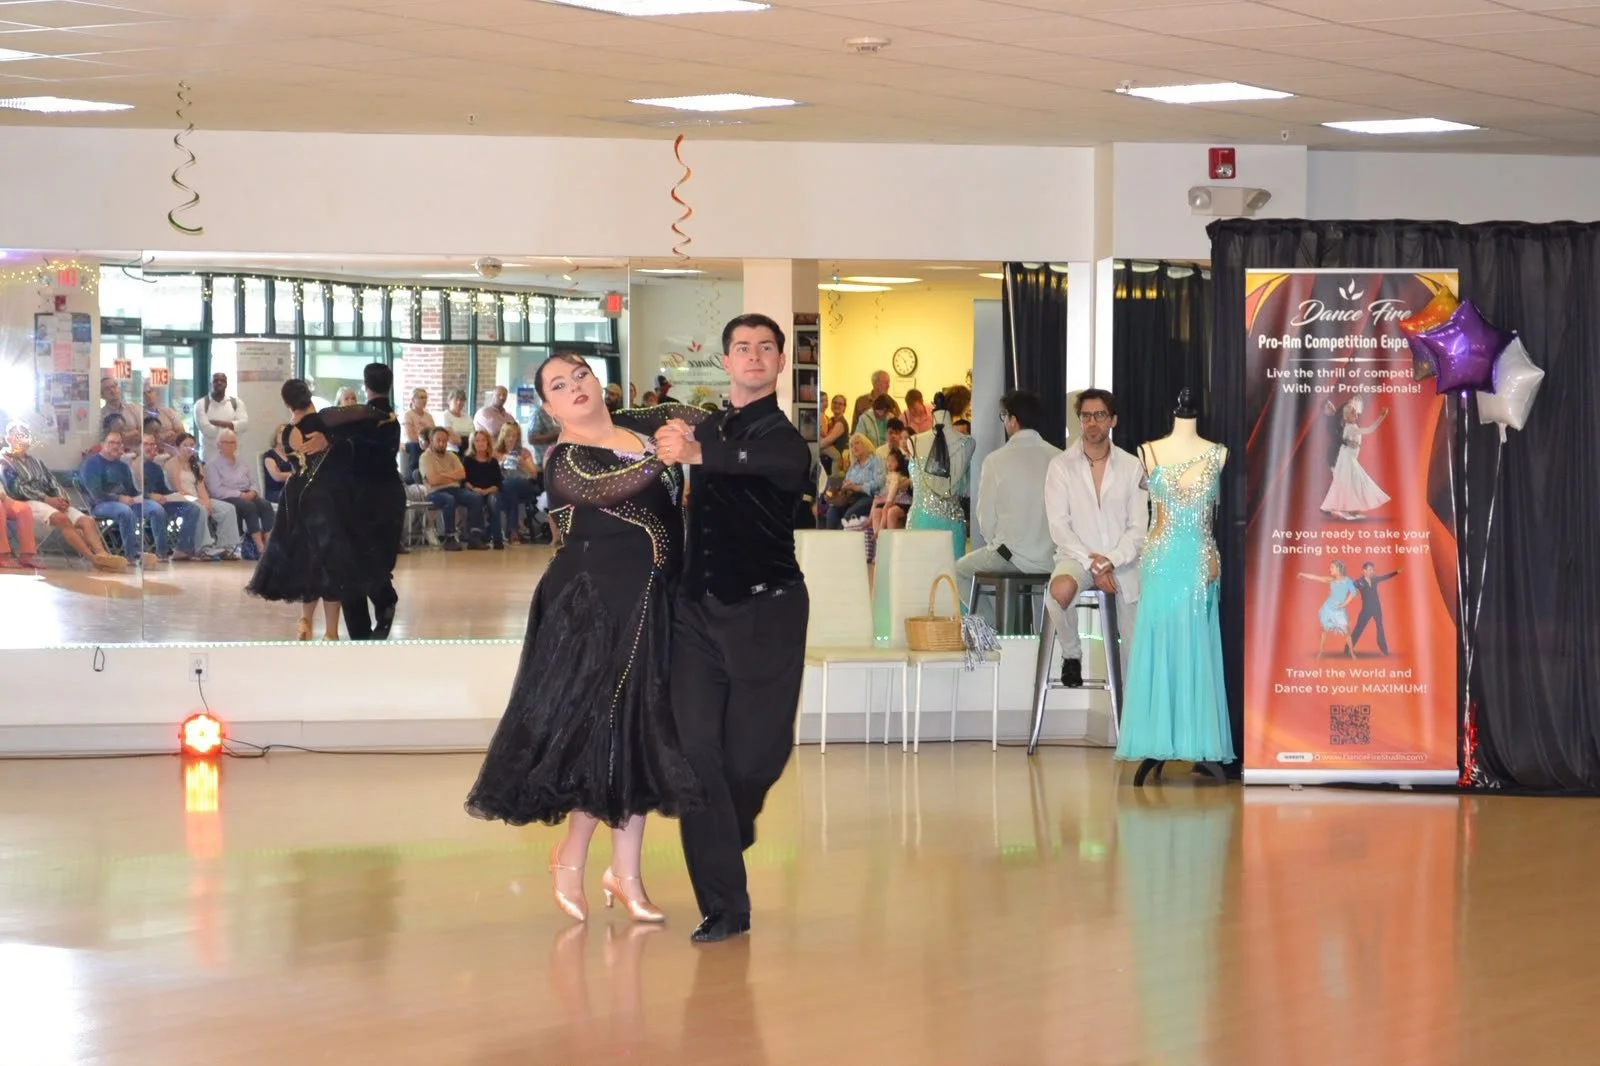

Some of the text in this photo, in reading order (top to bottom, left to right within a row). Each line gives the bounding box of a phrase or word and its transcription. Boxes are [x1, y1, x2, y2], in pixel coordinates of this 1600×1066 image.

[1290, 299, 1412, 327] Dance Fire
[1258, 334, 1301, 349] Pro-Am
[1305, 333, 1377, 351] Competition
[1267, 368, 1290, 378] Live
[1294, 368, 1313, 378] the
[1317, 368, 1345, 378] thrill
[1348, 368, 1361, 378] of
[1282, 383, 1421, 393] With our Professionals!
[1272, 529, 1430, 541] Are you ready to take your
[1272, 544, 1430, 556] Dancing to the next level?
[1286, 668, 1412, 678] Travel the World and
[1274, 683, 1427, 695] Dance to your MAXIMUM!
